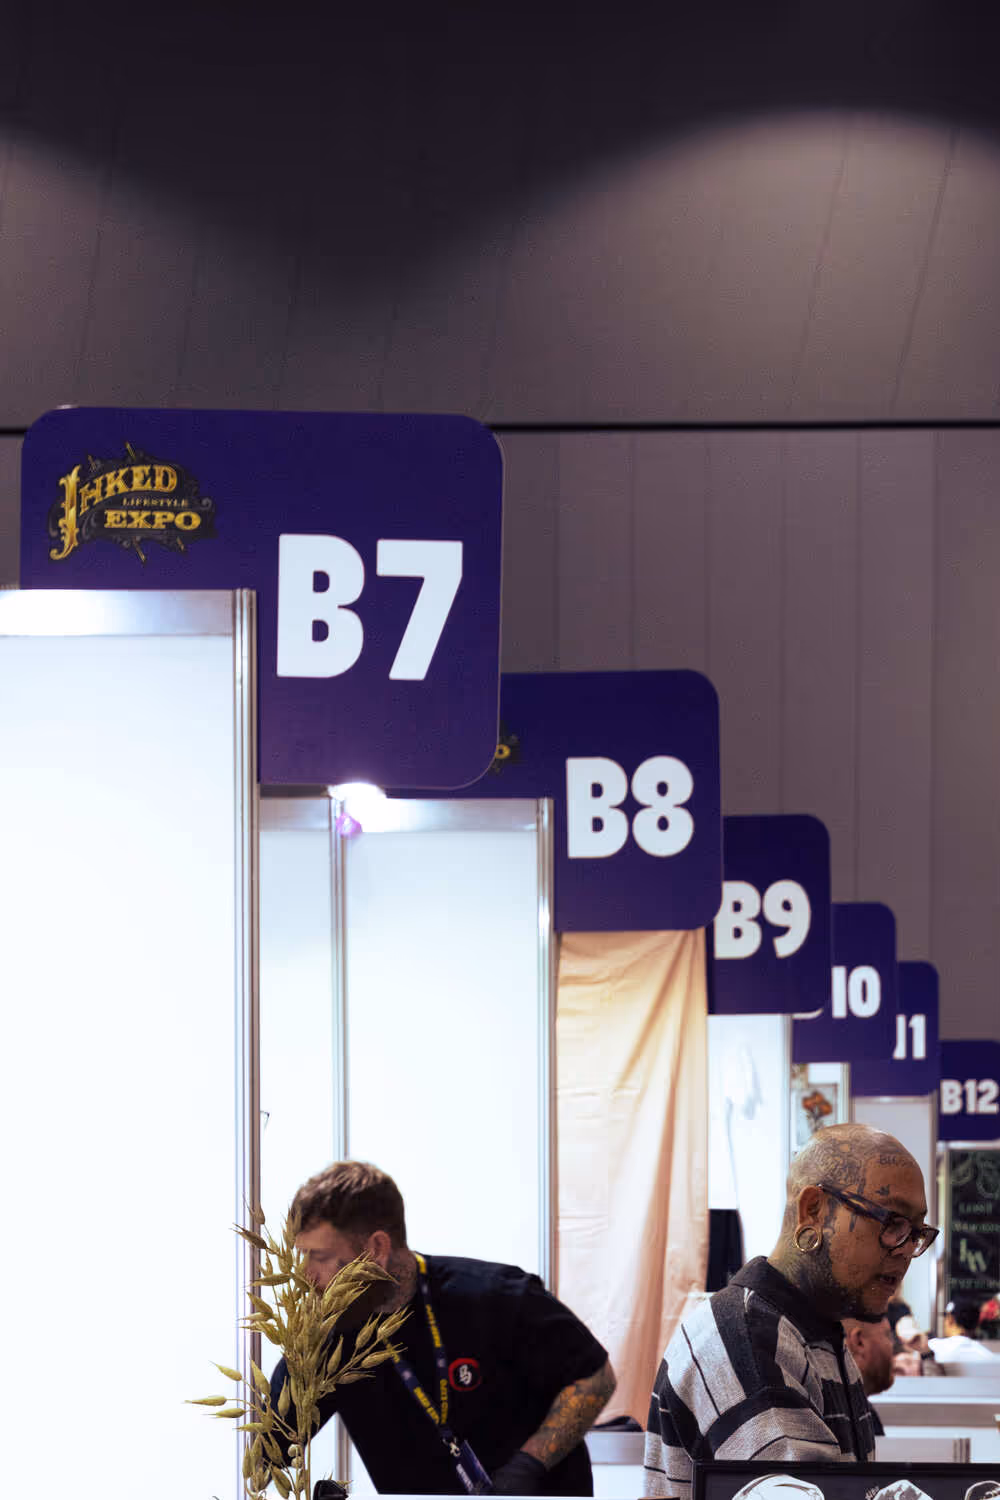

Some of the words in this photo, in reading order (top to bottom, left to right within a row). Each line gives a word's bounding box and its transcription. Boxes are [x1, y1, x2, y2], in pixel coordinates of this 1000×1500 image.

[50, 464, 177, 560] INKED
[104, 509, 201, 531] EXPO
[122, 497, 189, 507] LIFESTYLE
[276, 533, 463, 681] B7
[566, 755, 694, 859] B8
[713, 879, 812, 959] B9
[792, 965, 881, 1018] 10
[893, 1014, 926, 1060] 11
[940, 1080, 999, 1114] B12
